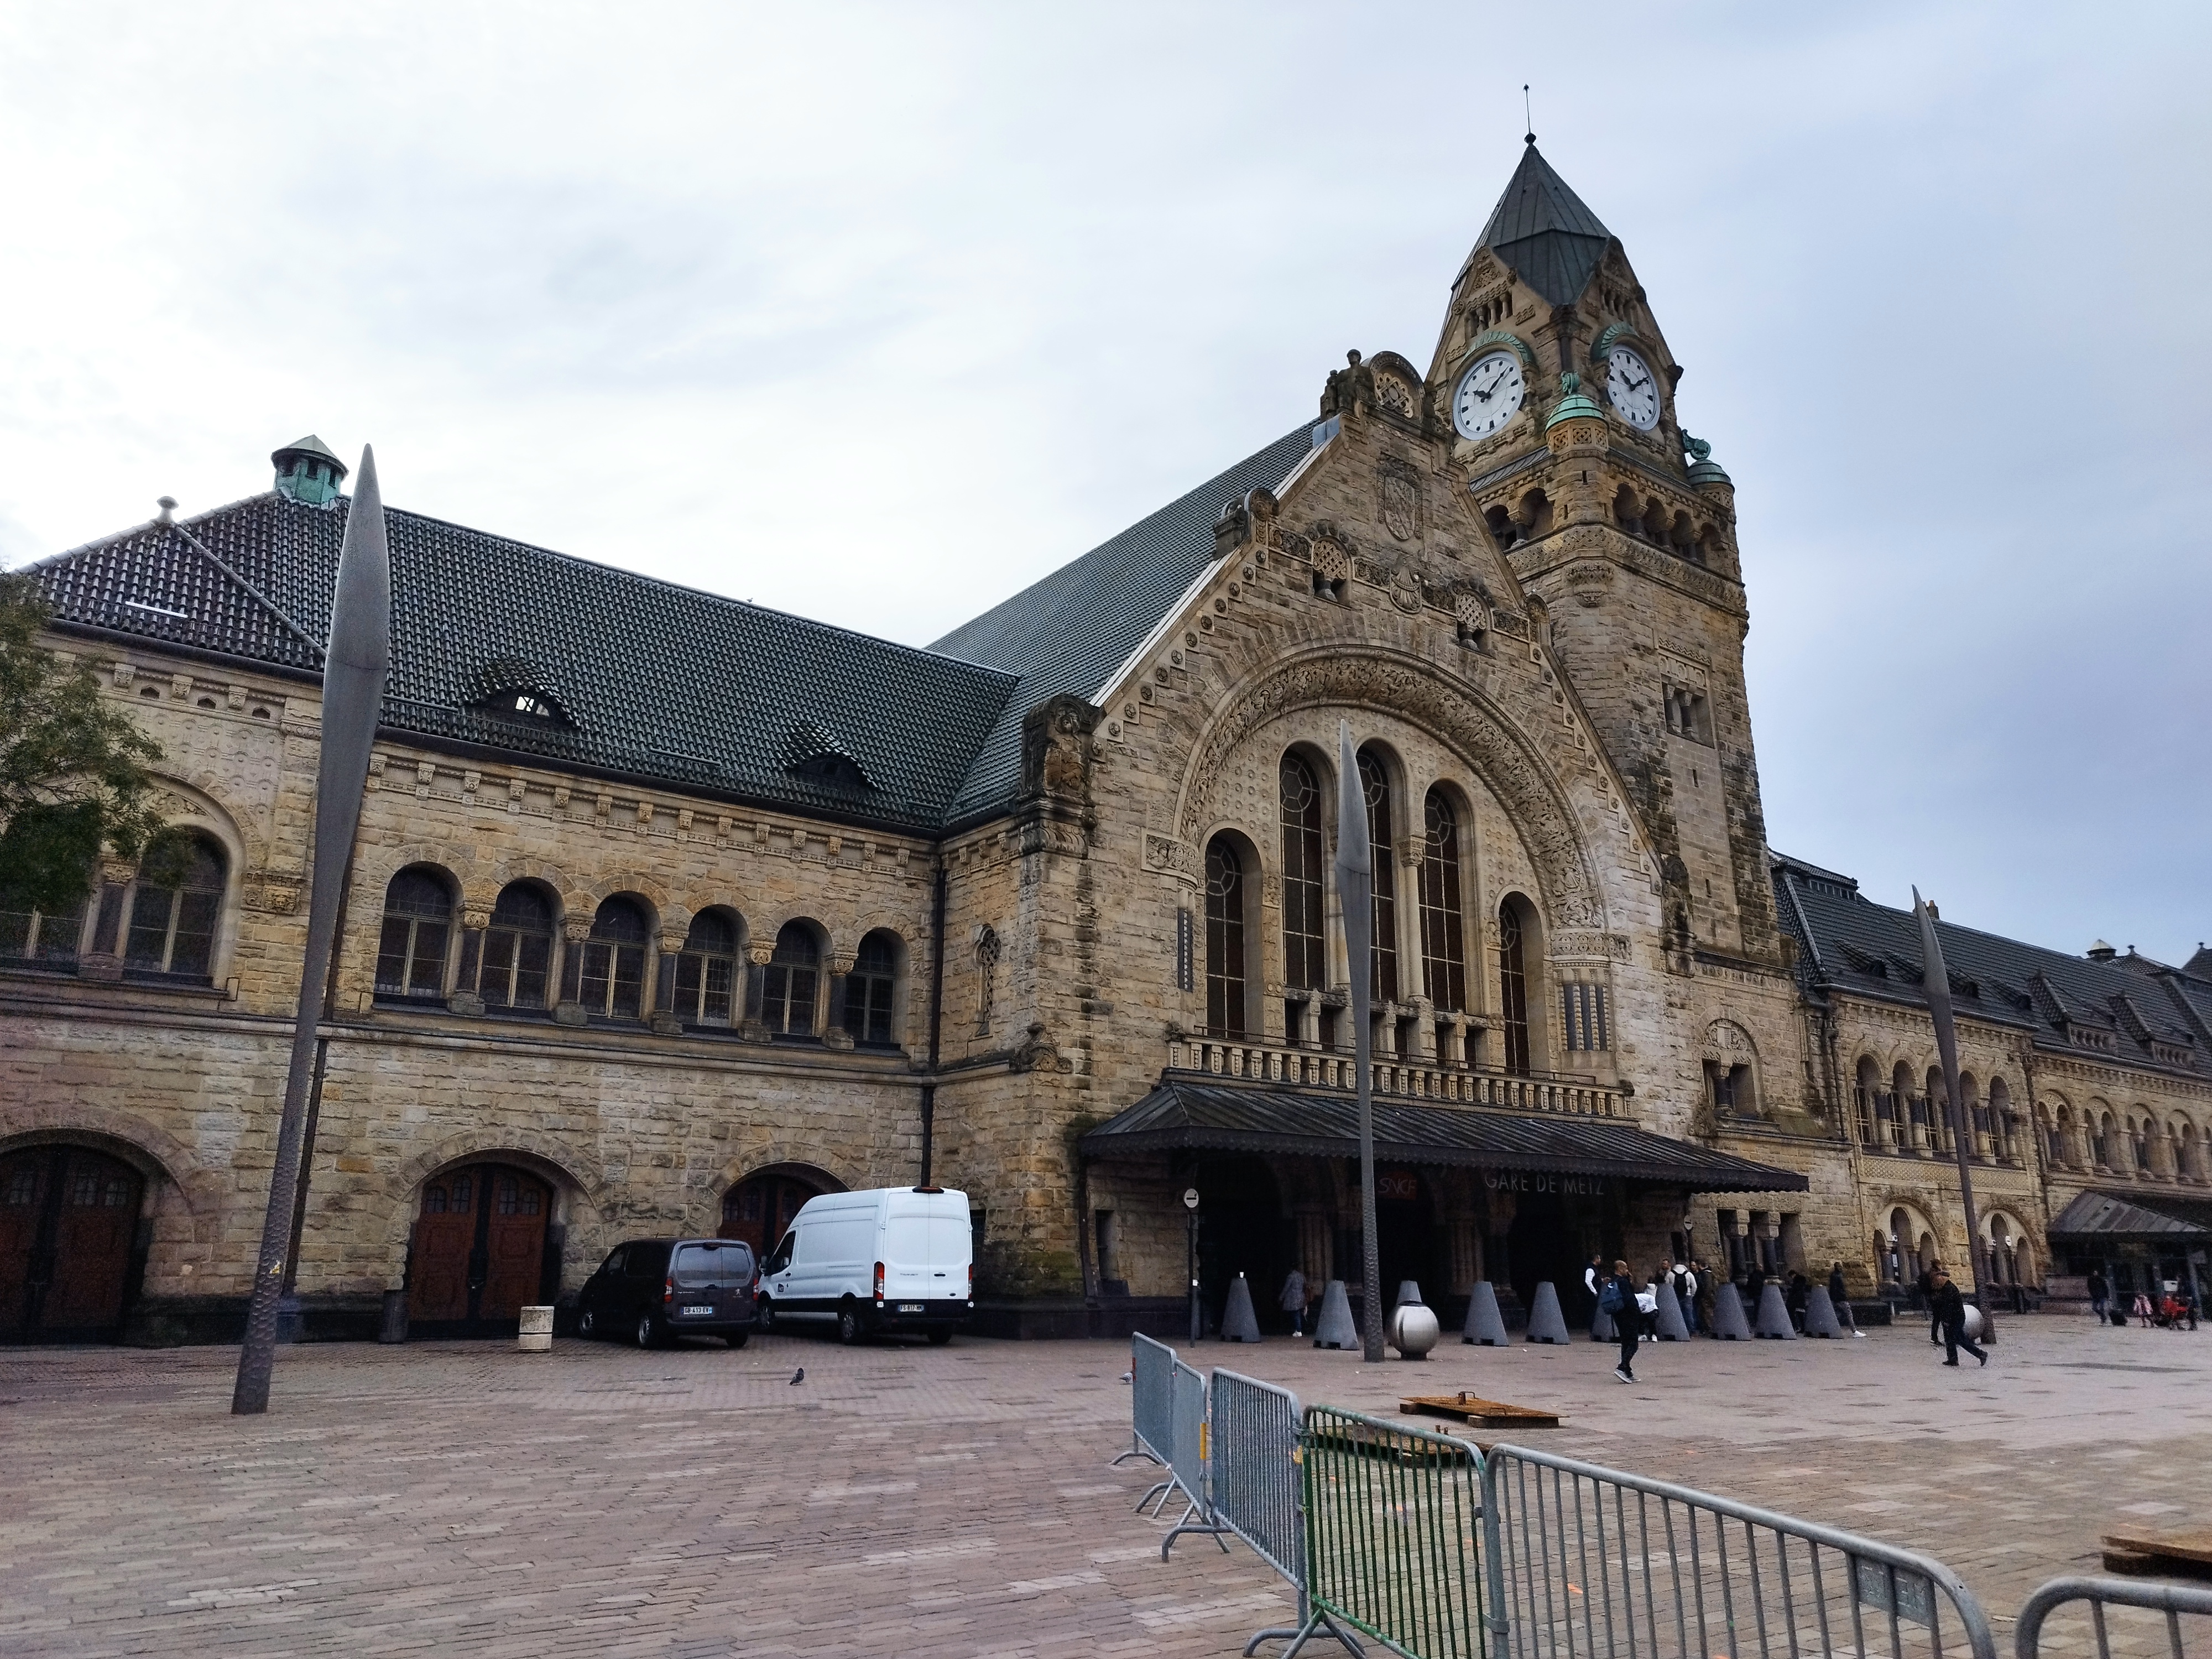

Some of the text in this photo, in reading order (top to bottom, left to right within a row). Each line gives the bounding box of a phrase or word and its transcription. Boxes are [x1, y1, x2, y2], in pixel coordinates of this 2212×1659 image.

[1378, 1177, 1417, 1196] SNCF
[1484, 1171, 1604, 1196] GARE DE METZ
